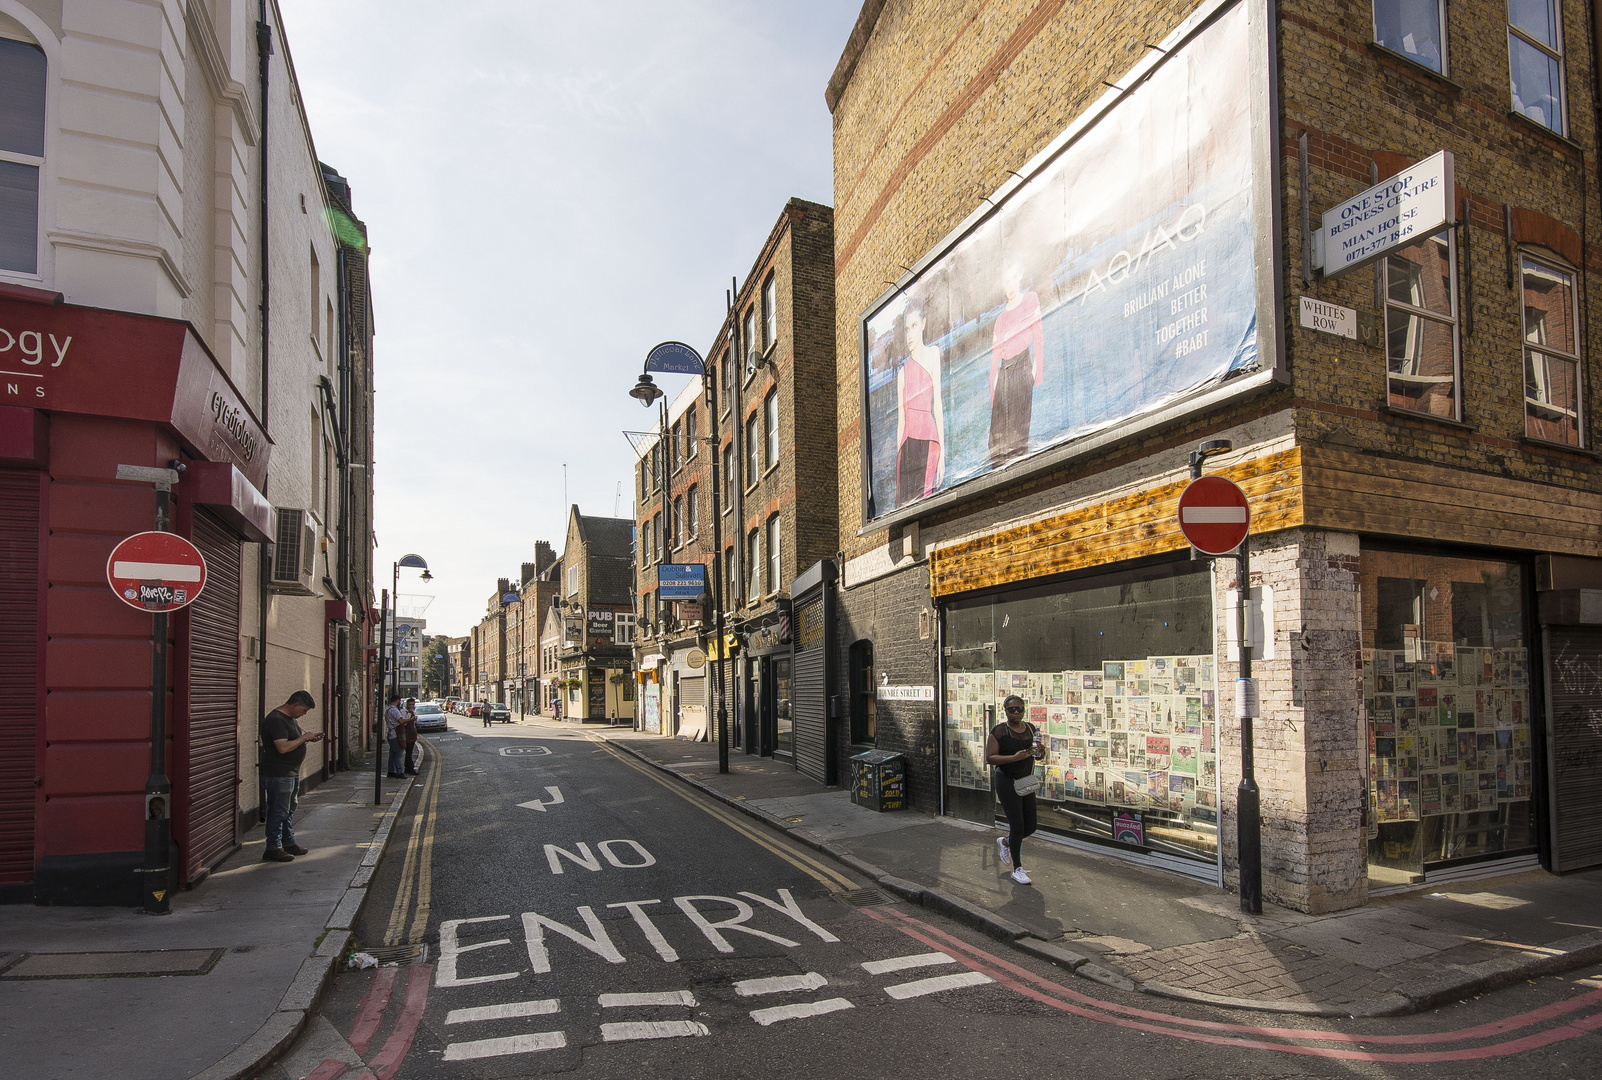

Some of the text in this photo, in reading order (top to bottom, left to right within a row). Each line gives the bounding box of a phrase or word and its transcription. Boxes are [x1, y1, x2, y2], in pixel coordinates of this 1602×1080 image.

[1330, 175, 1438, 237] BUSINESS CENTRE
[1341, 175, 1413, 220] ONE STOP
[1342, 207, 1418, 250] MIAN HOUSE
[1346, 224, 1413, 263] 0171-377 1848
[1124, 259, 1207, 318] BRILLIANT ALONE
[1171, 284, 1208, 316] BETTER
[1155, 307, 1208, 345] TOGETHER
[1303, 300, 1345, 321] WHITES
[1313, 316, 1337, 331] ROW
[650, 346, 701, 370] Petticoat Lane
[1175, 329, 1209, 359] #BABT
[663, 362, 689, 372] Market
[212, 391, 257, 462] eyediology
[588, 611, 613, 621] PUB
[900, 689, 920, 697] STREET
[924, 689, 932, 697] E1
[1116, 821, 1141, 831] payzone
[543, 838, 657, 875] NO
[435, 888, 841, 988] ENTRY
